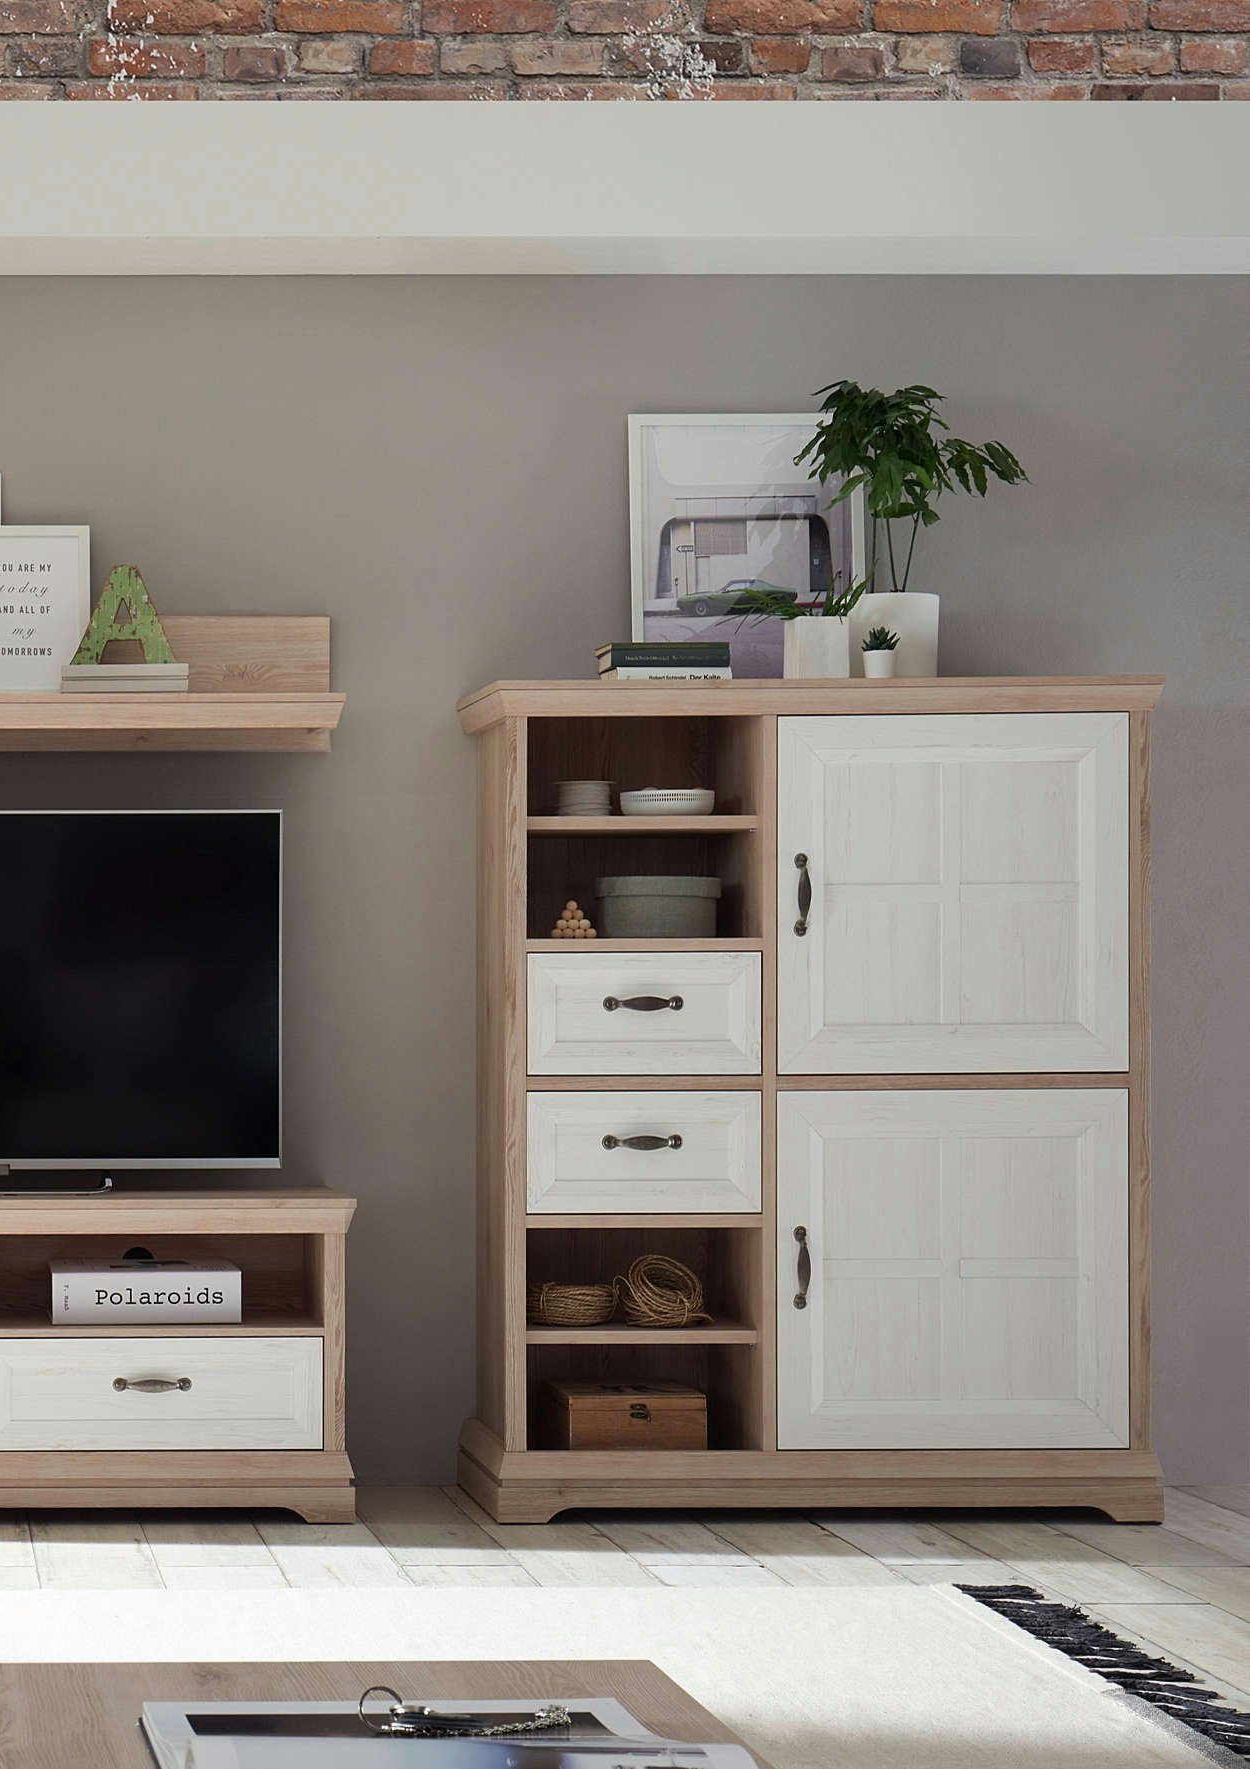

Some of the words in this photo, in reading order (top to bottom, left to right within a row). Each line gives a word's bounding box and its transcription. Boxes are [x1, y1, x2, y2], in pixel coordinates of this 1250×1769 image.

[17, 563, 35, 572] ARE
[39, 563, 52, 572] MY
[19, 605, 35, 614] ALL
[40, 605, 51, 614] OF
[70, 564, 177, 664] A
[12, 628, 35, 639] my
[95, 1287, 224, 1305] Polaroids
